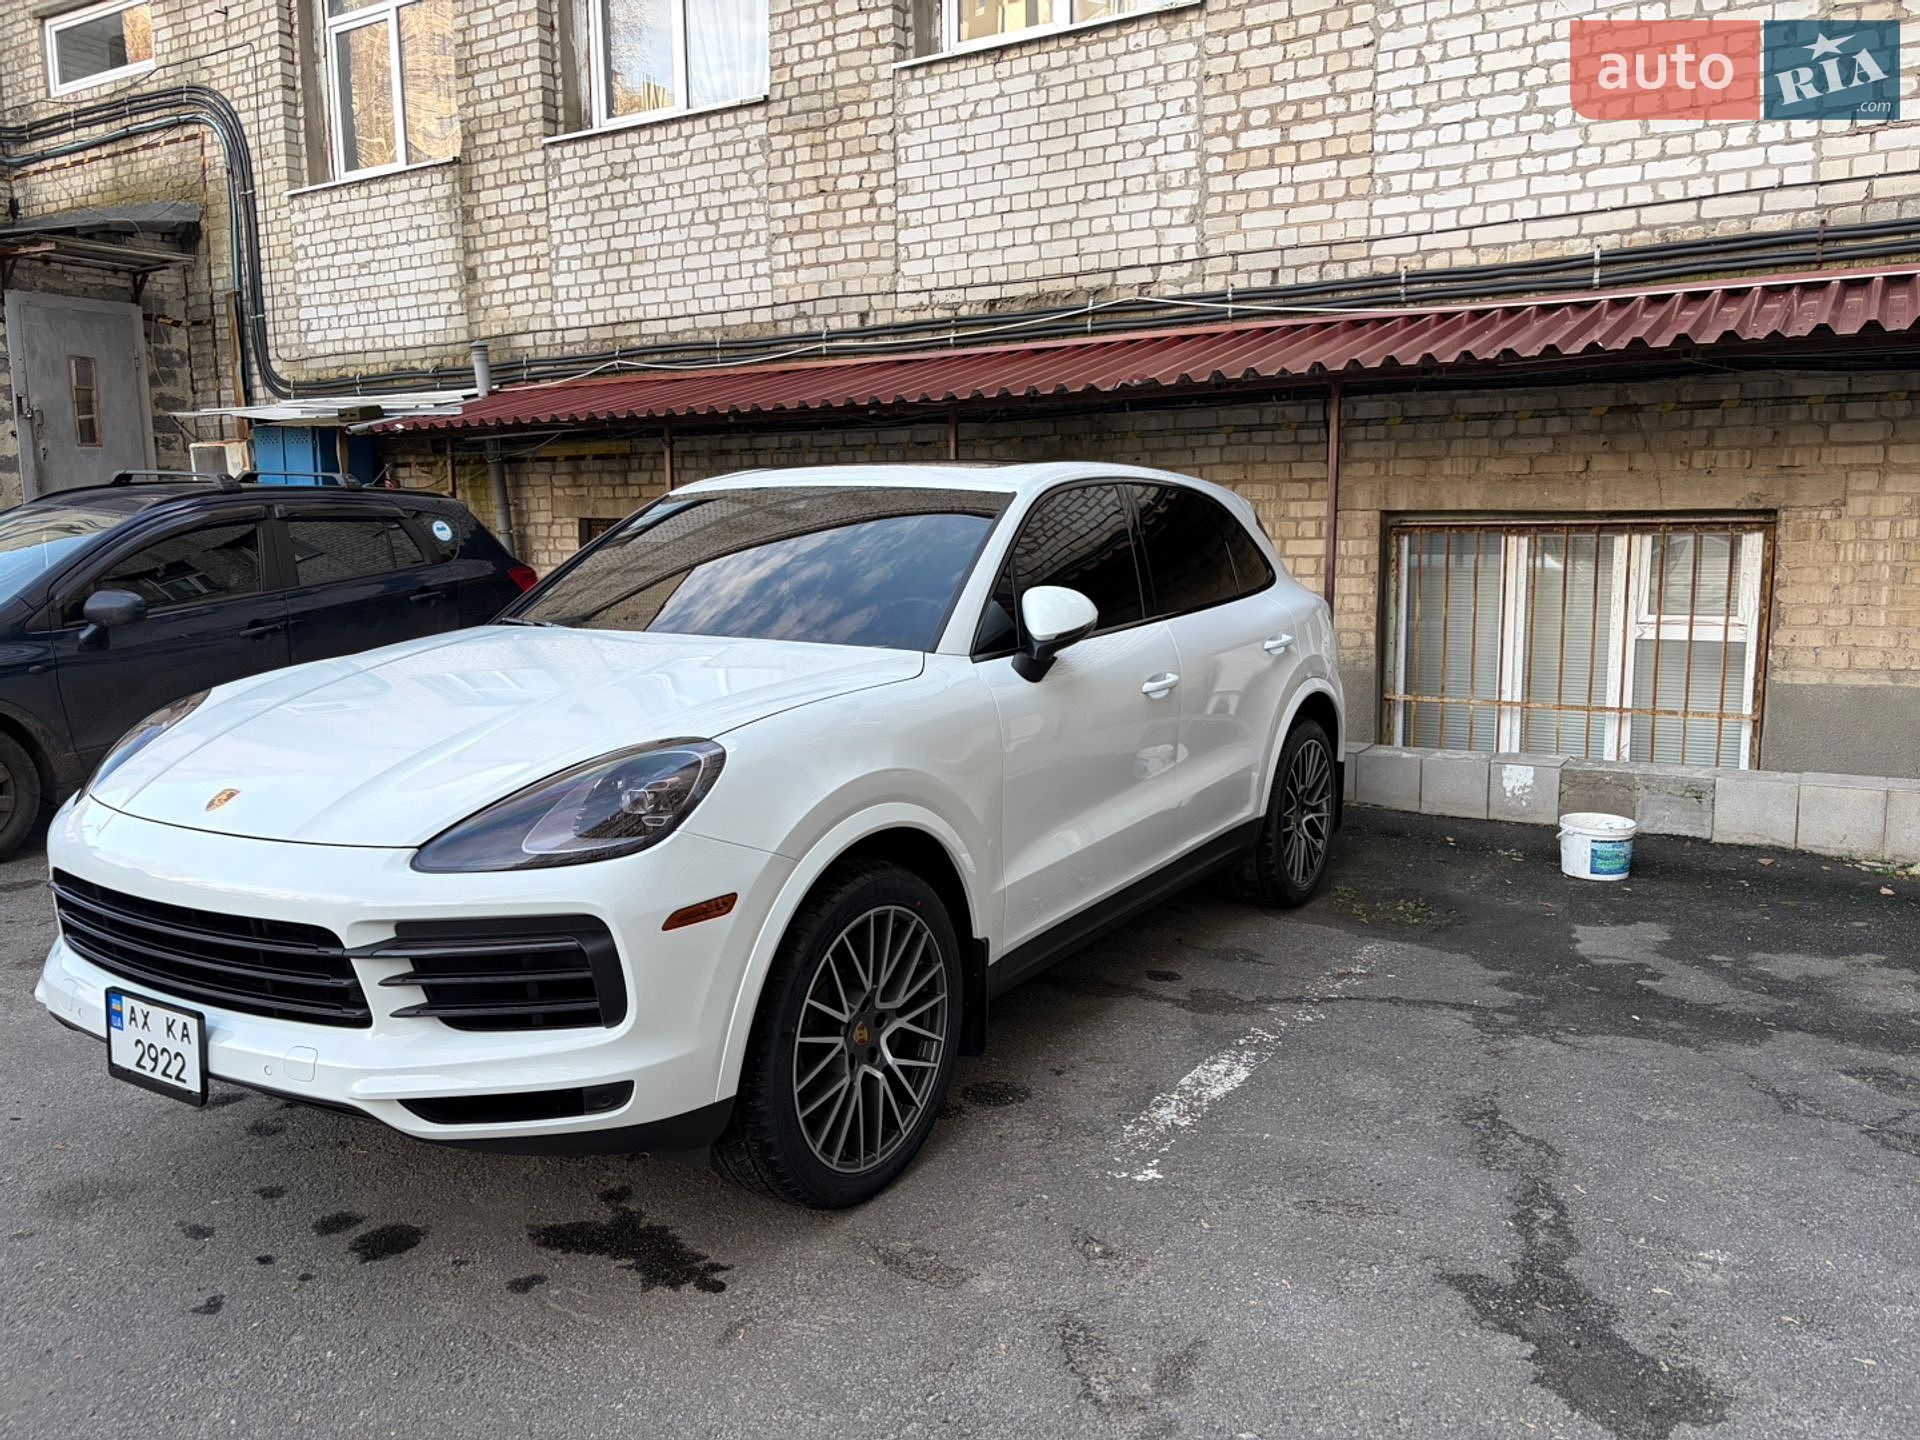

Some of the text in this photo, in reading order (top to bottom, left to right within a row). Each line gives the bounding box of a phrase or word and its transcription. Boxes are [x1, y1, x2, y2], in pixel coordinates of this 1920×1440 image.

[128, 1005, 191, 1045] AX KA
[134, 1038, 187, 1084] 2922
